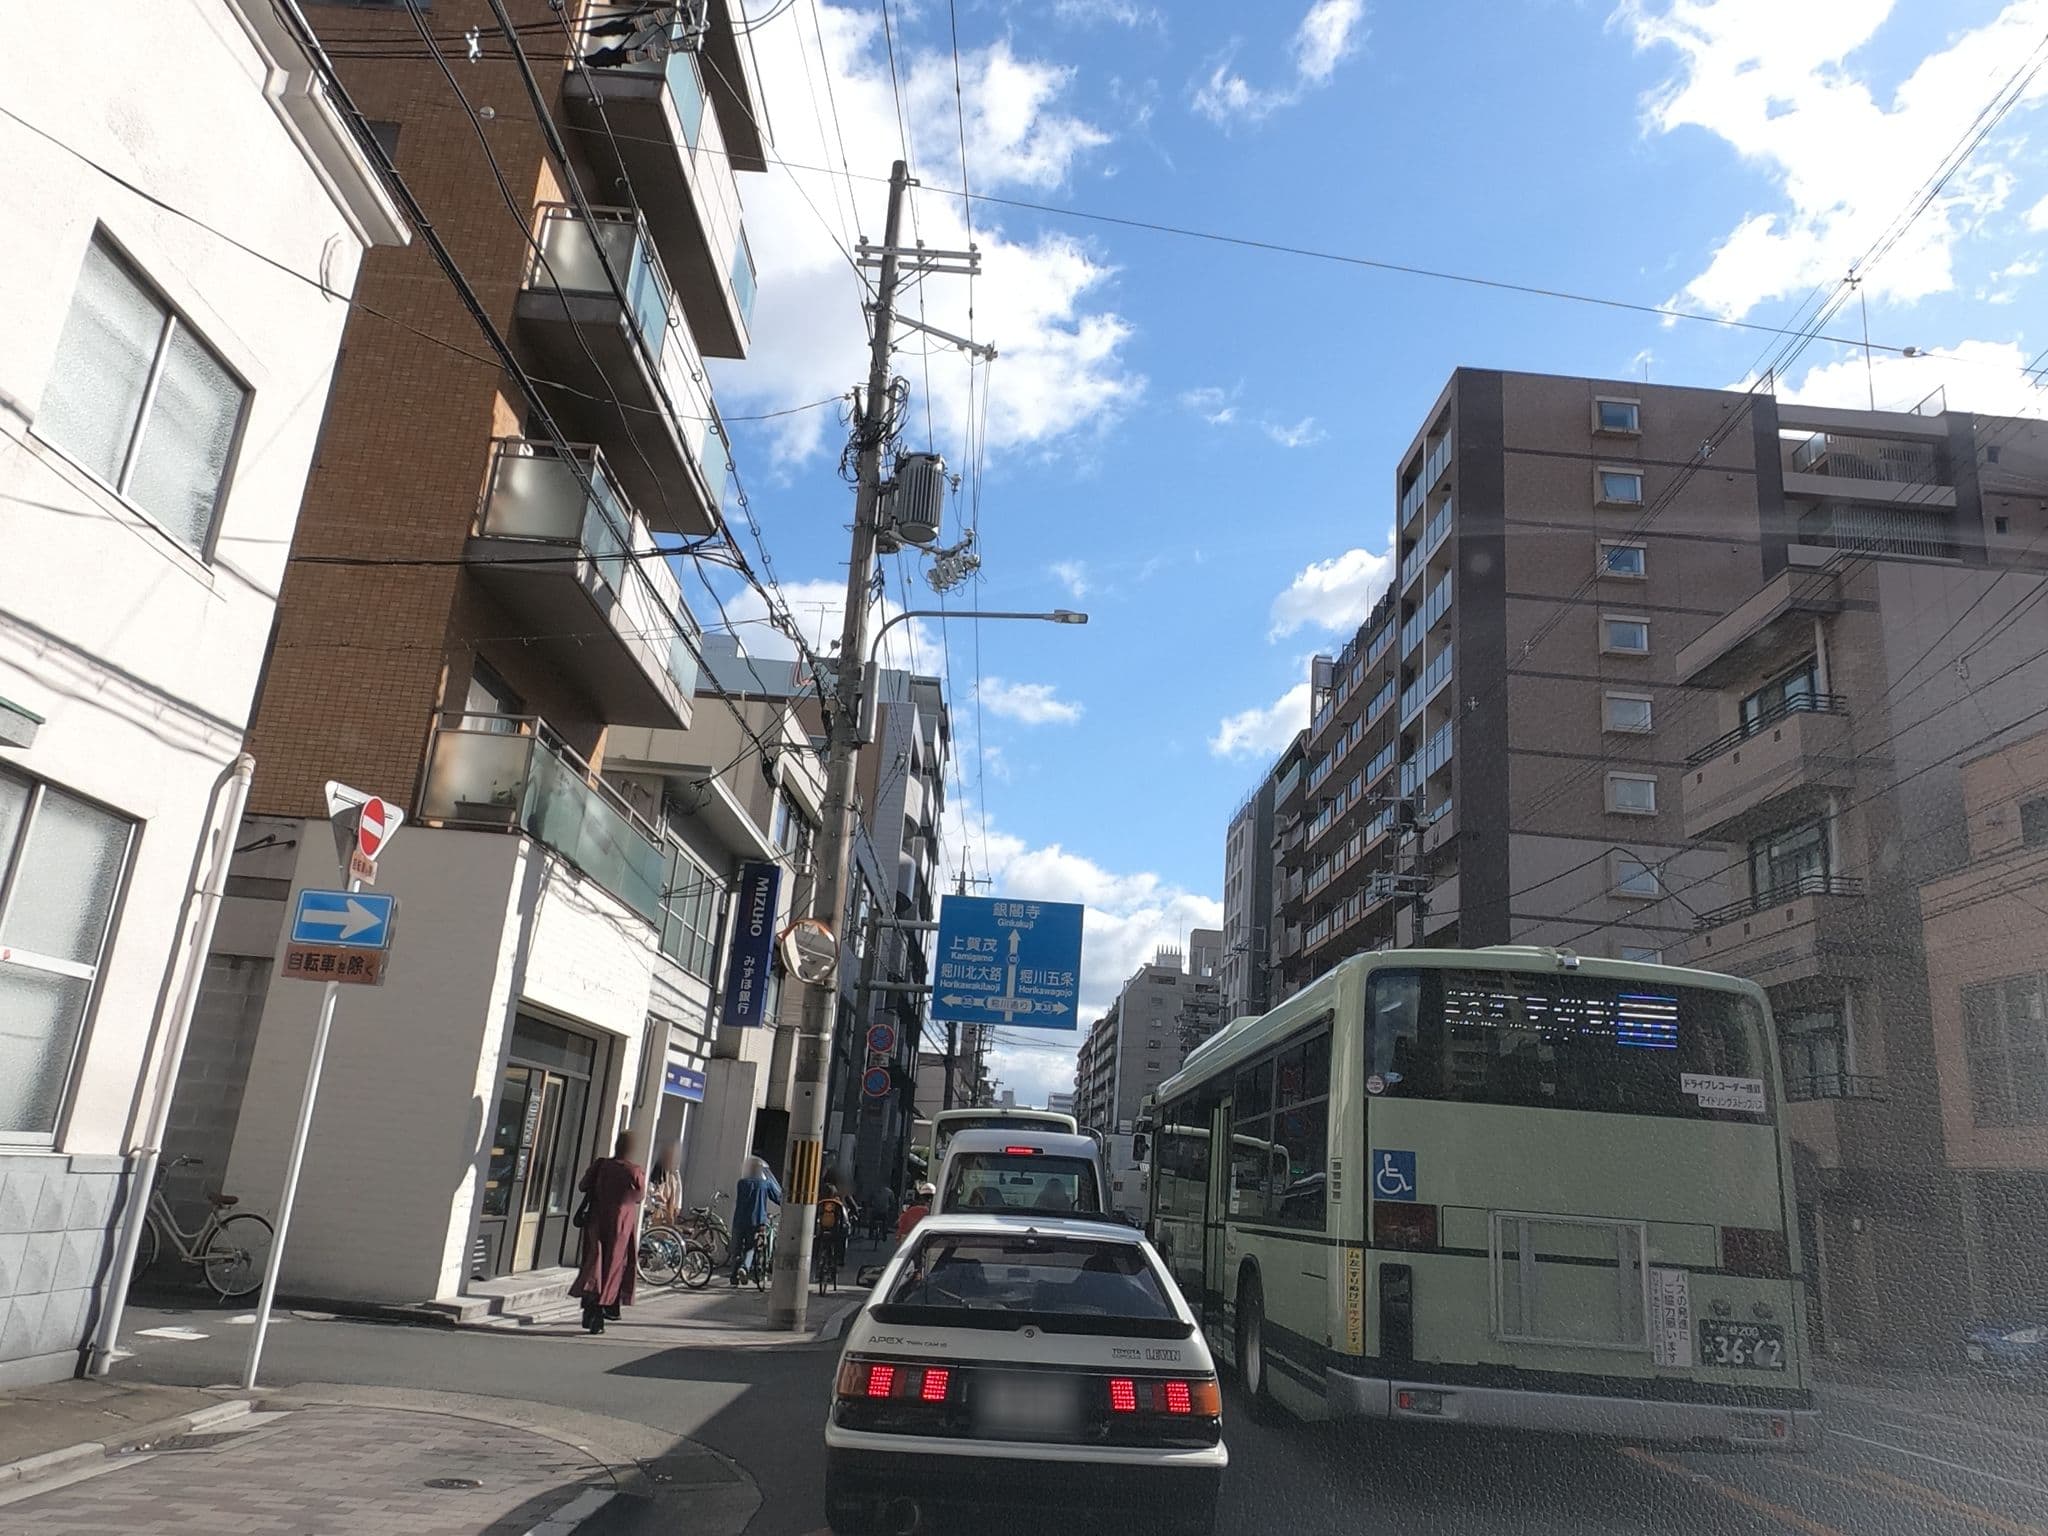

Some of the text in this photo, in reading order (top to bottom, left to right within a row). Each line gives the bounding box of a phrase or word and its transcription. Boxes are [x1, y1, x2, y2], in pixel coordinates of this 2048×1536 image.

[750, 877, 769, 937] MIZUHO
[992, 902, 1041, 919] 銀閣寺
[950, 936, 998, 953] 上賀茂
[288, 952, 373, 977] 自転車を除く
[951, 952, 994, 962] Kamigamo
[941, 963, 1002, 982] 堀川北大路
[1019, 969, 1074, 987] 堀川五条
[737, 955, 756, 1015] みずほ銀行
[869, 1335, 904, 1344] APEX
[1145, 1348, 1181, 1361] LEVIN
